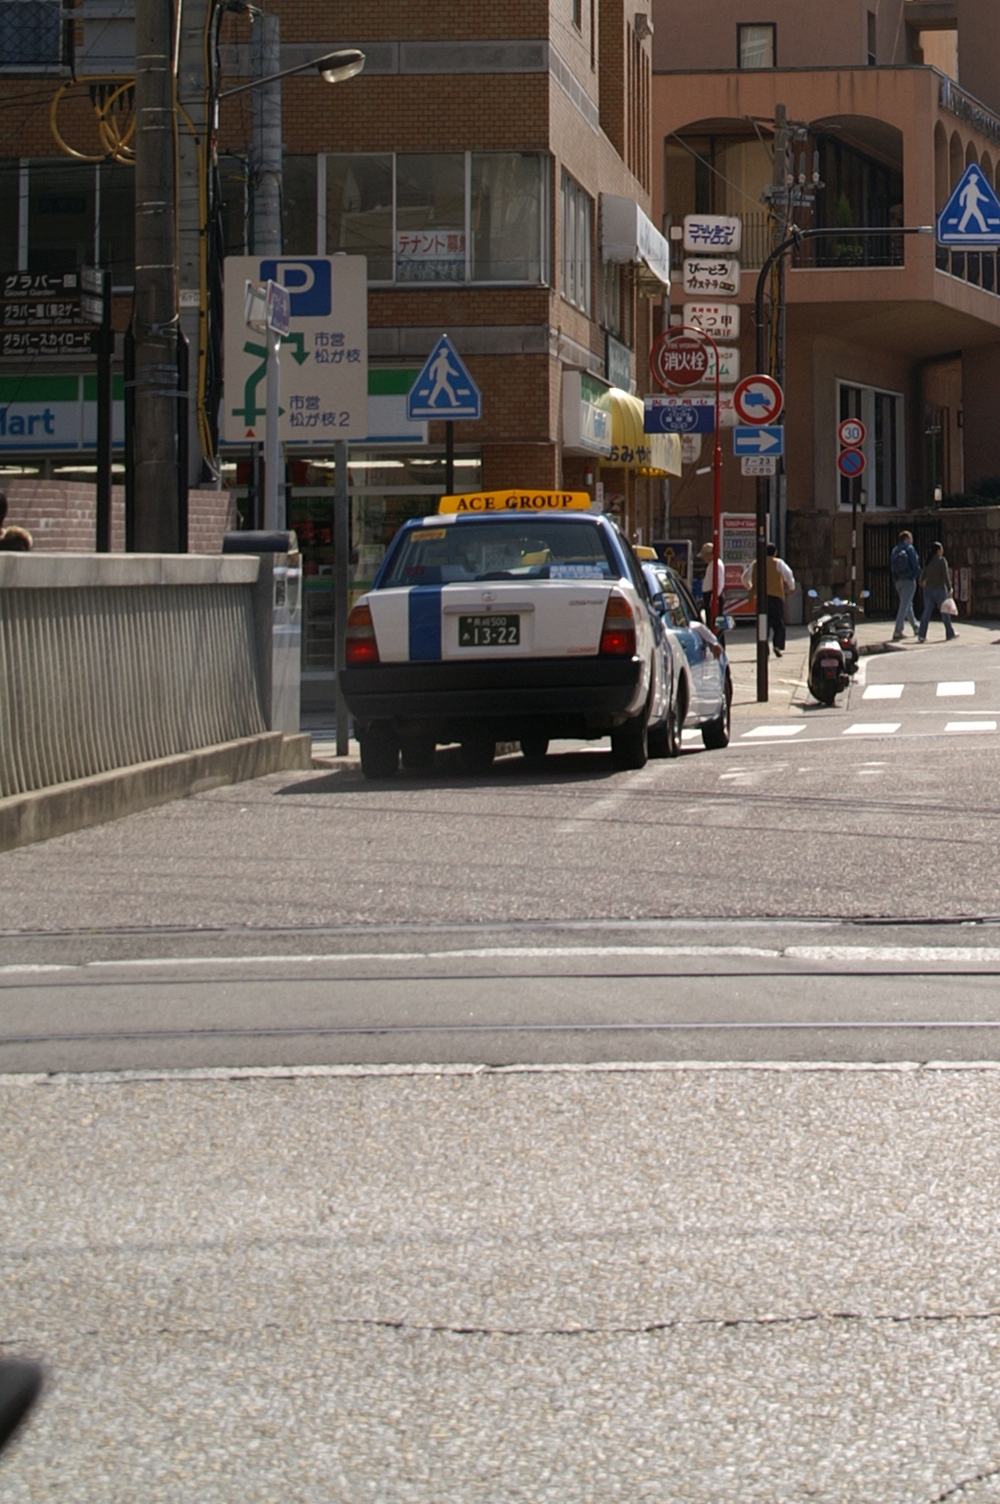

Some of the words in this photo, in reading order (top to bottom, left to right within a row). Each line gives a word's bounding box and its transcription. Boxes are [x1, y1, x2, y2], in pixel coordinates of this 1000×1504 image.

[276, 262, 315, 294] P
[686, 275, 719, 289] カステラ
[314, 331, 345, 347] 市営
[314, 349, 362, 364] 松が枝
[664, 351, 705, 371] 消火栓
[289, 395, 321, 410] 市営
[844, 426, 860, 440] 30
[604, 445, 652, 464] おみや
[456, 497, 496, 511] ACE
[505, 495, 573, 510] GROUP
[474, 627, 517, 644] 13-22
